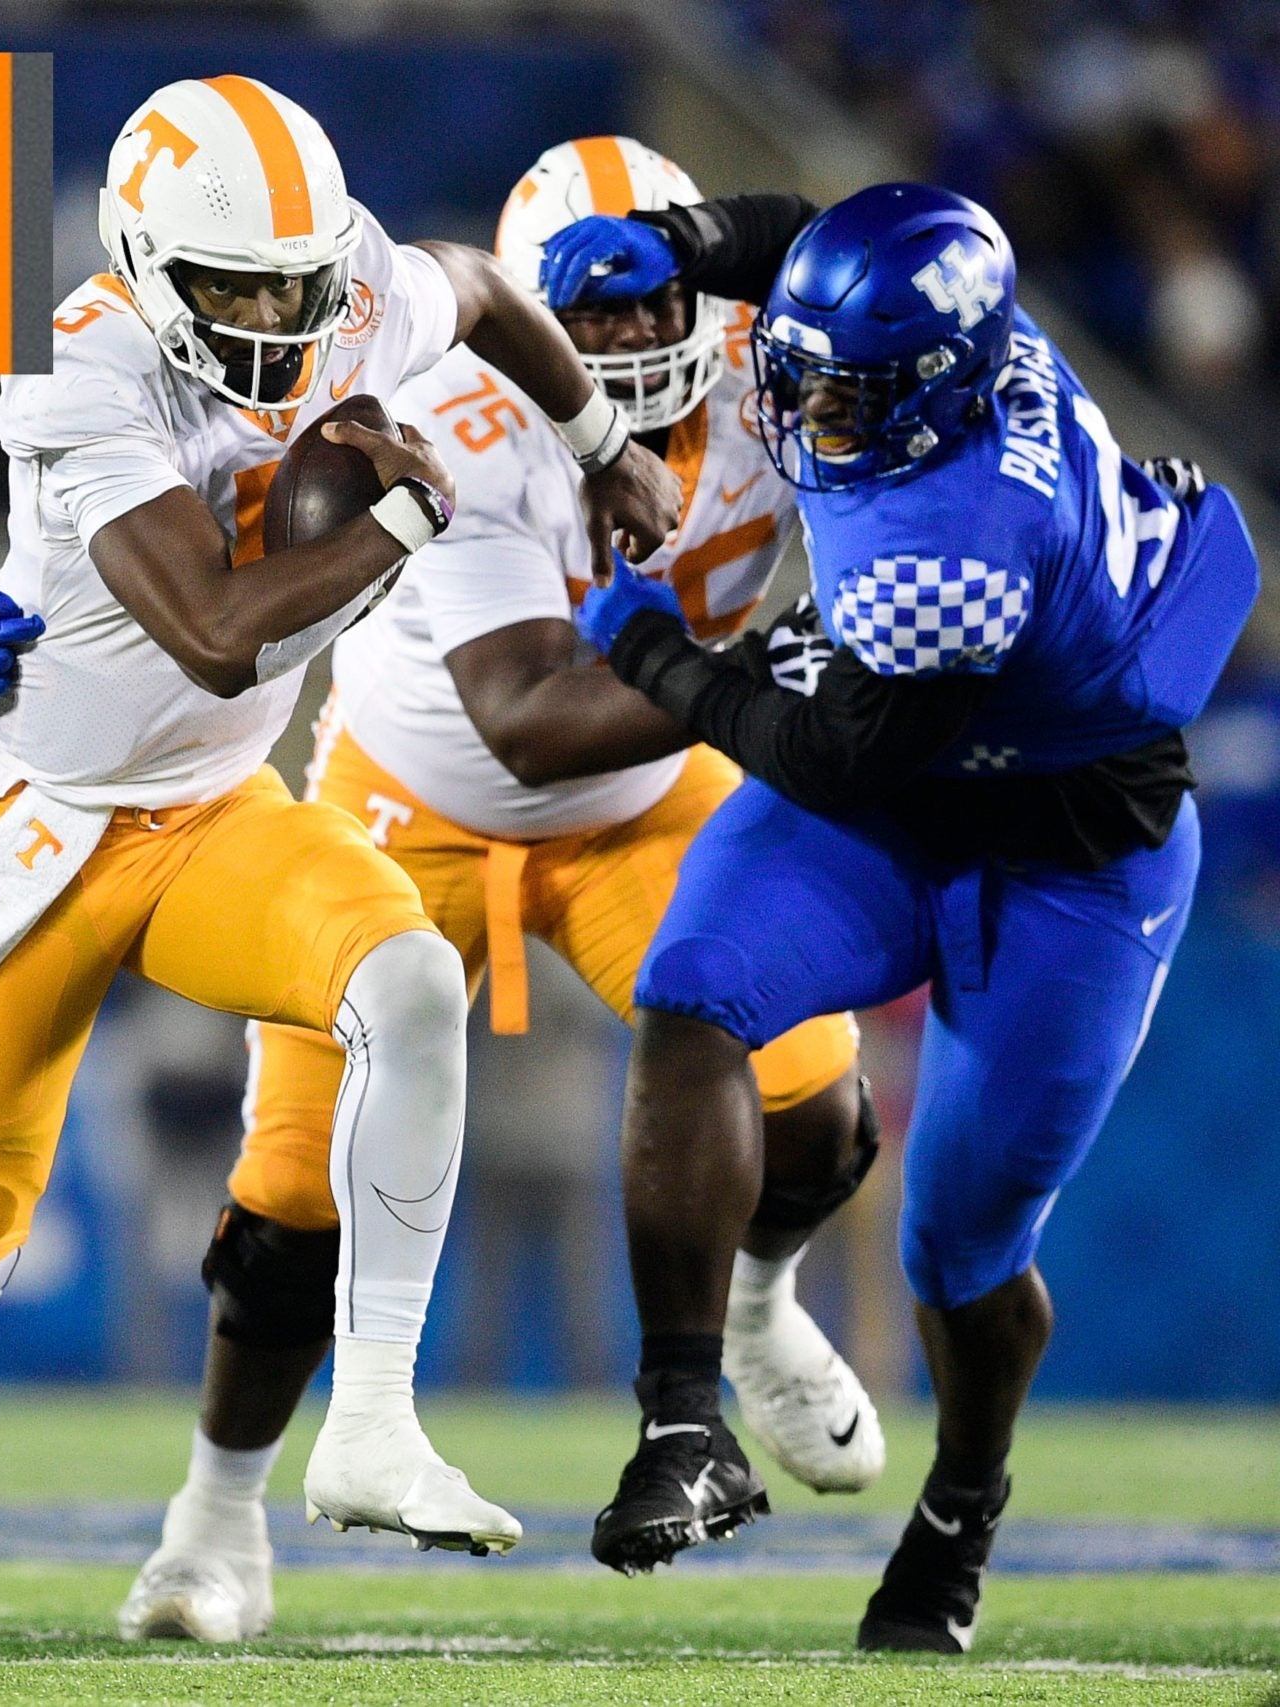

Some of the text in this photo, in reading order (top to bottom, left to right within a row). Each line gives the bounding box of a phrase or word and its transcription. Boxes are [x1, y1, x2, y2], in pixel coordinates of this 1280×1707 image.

[119, 109, 200, 214] T
[281, 240, 309, 250] VICIS
[339, 308, 385, 346] GRADUATE
[432, 371, 529, 455] 75
[15, 817, 64, 871] T
